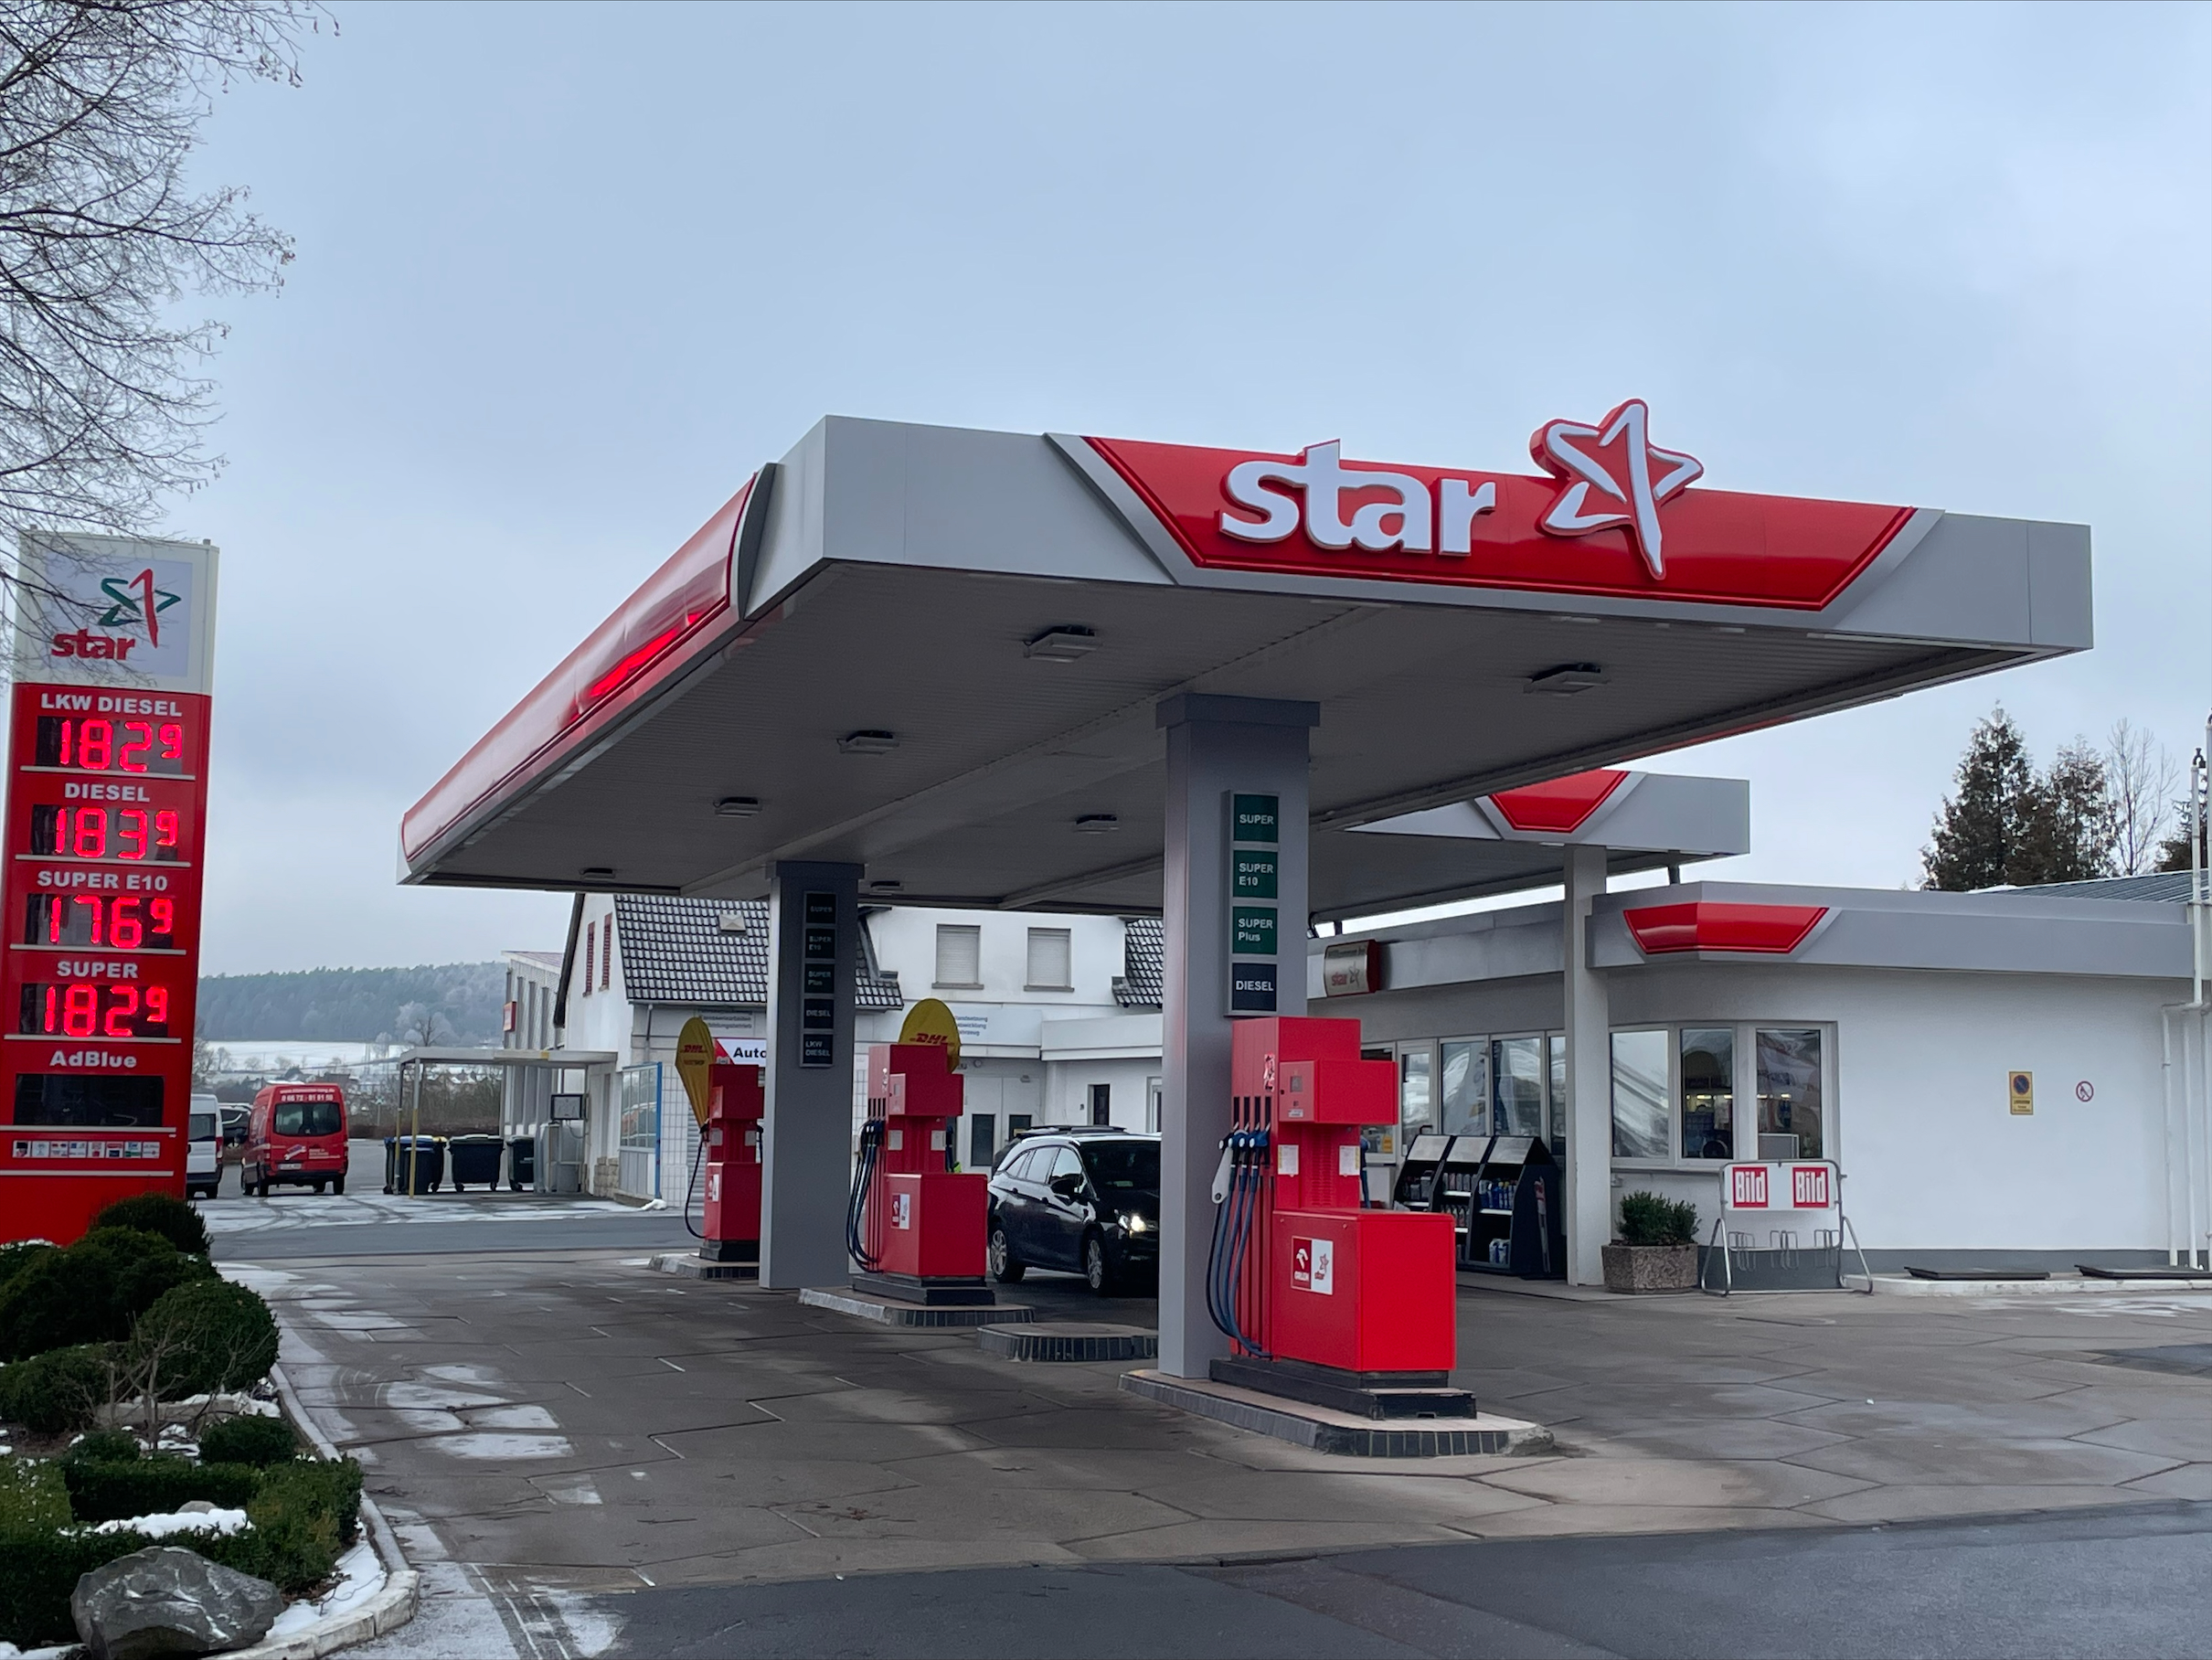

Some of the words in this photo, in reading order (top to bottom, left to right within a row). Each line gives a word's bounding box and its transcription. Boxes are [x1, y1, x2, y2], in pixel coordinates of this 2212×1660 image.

[1220, 439, 1496, 555] star
[51, 628, 135, 660] star
[41, 693, 93, 711] LKW
[98, 697, 183, 718] DIESEL
[64, 782, 151, 803] DIESEL
[1239, 814, 1274, 825] SUPER
[1239, 863, 1274, 874] SUPER
[37, 870, 120, 890] SUPER
[125, 873, 168, 892] E10
[1239, 876, 1259, 886] E10
[1239, 918, 1273, 929] SUPER
[1239, 931, 1260, 942] Plus
[57, 960, 139, 979] SUPER
[808, 970, 832, 978] SUPER
[1236, 980, 1274, 993] DIESEL
[806, 1009, 831, 1017] DIESEL
[805, 1040, 823, 1048] LKW
[733, 1047, 767, 1059] Auto
[805, 1048, 831, 1057] DIESEL
[49, 1050, 137, 1069] AdBlue
